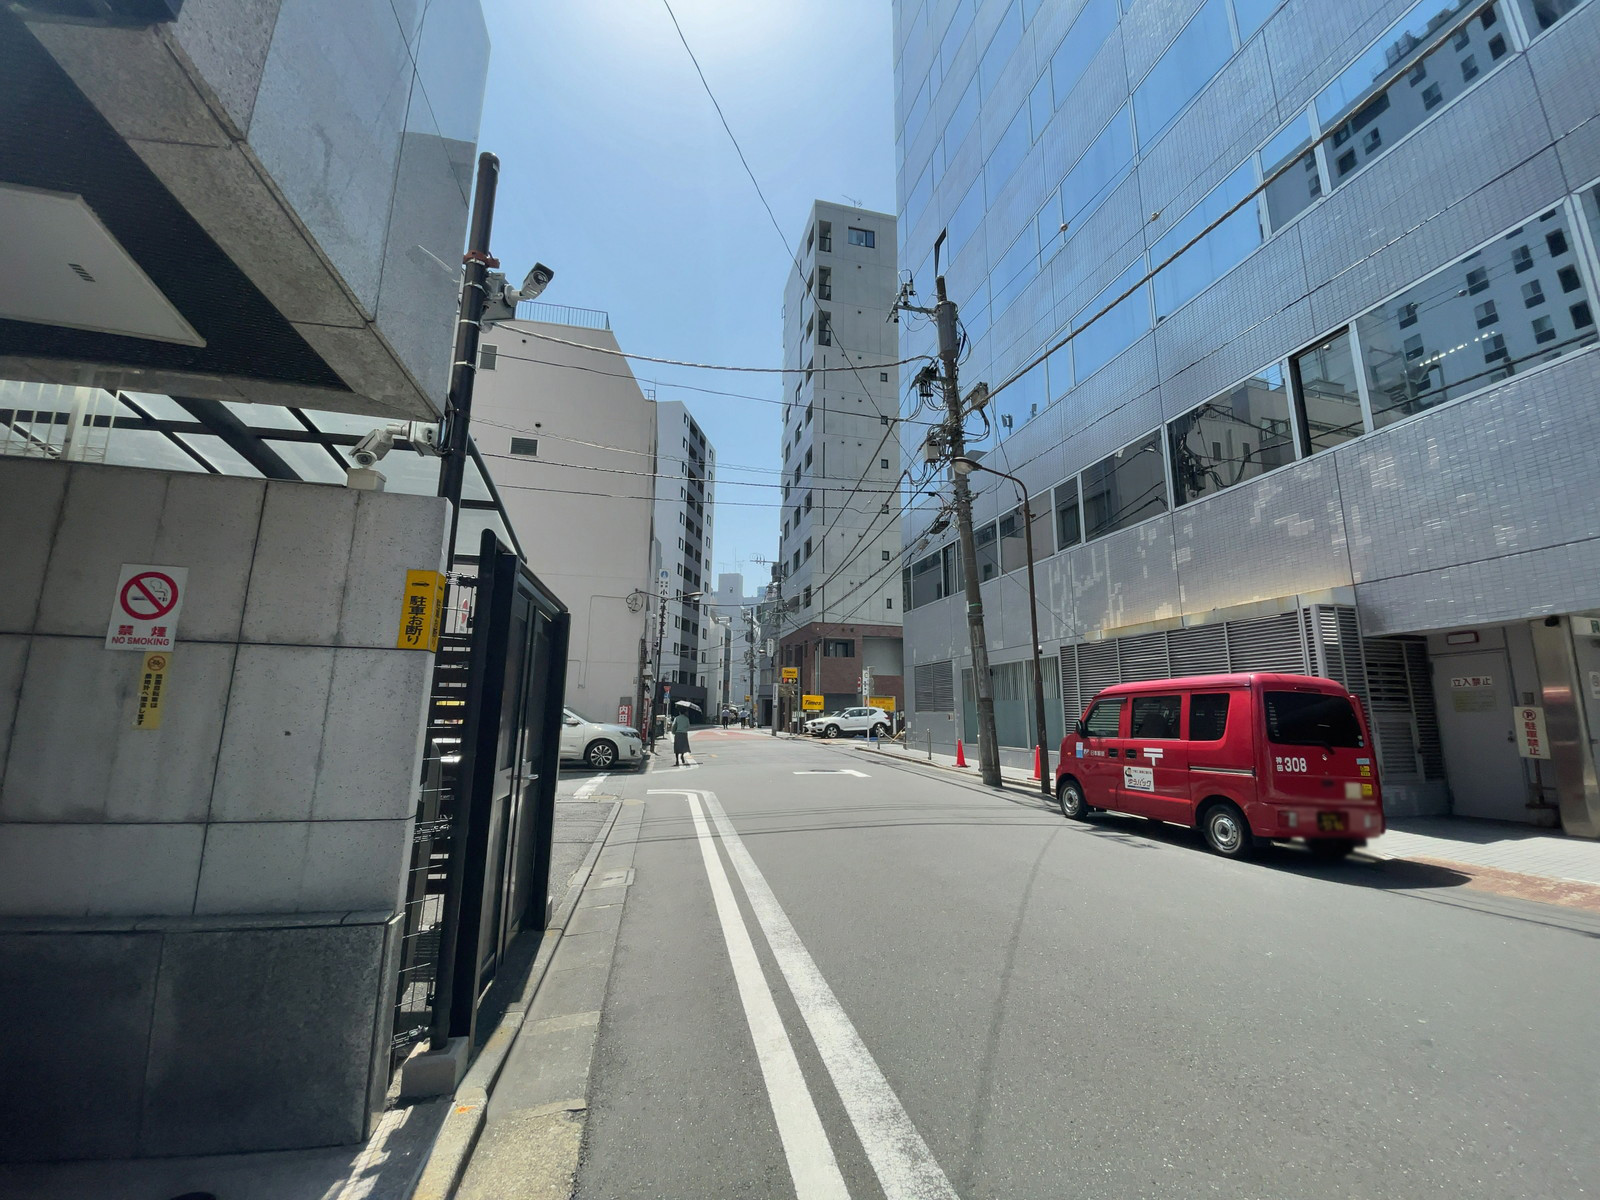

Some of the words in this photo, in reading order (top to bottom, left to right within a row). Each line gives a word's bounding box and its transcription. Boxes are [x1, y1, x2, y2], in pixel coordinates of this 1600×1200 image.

[405, 595, 427, 645] 駐車お断り
[111, 636, 126, 644] NO
[126, 637, 170, 646] SMOKING
[1452, 677, 1491, 687] 立入禁止
[1524, 721, 1541, 756] 駐車禁止
[1284, 757, 1307, 772] 308
